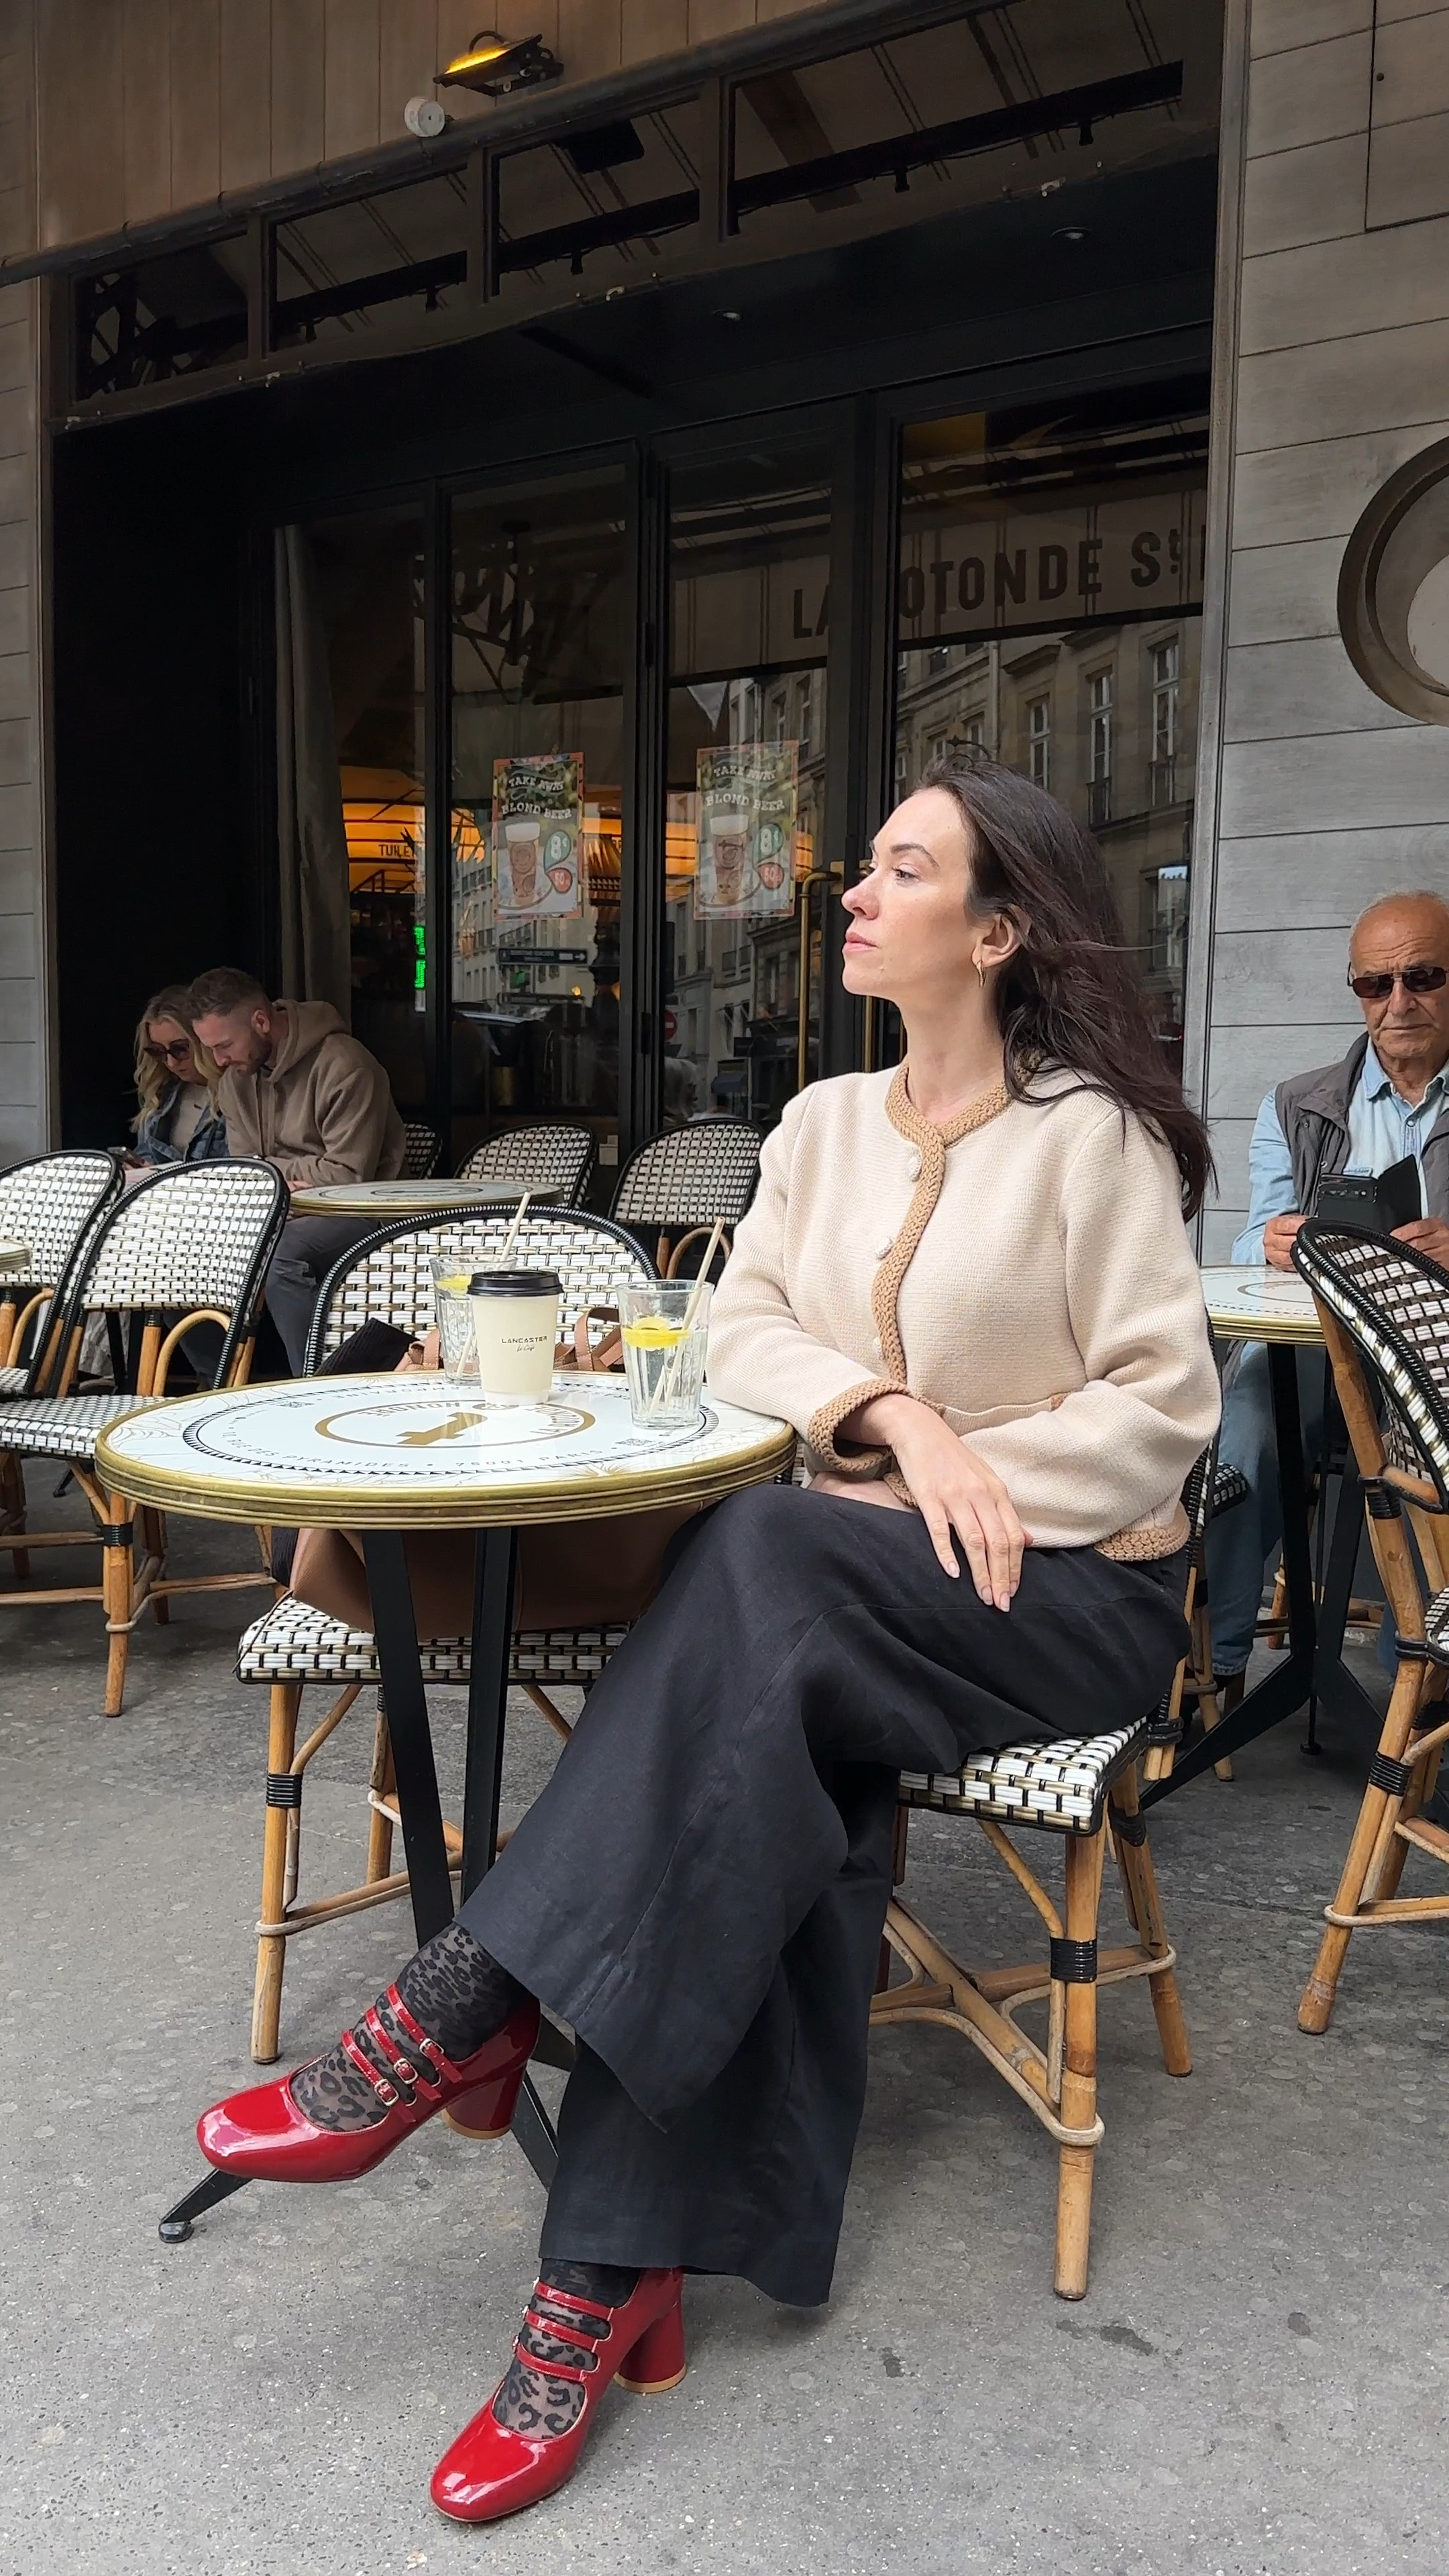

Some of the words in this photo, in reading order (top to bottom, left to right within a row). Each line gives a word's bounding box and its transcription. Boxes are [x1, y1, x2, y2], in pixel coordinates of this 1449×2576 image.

[899, 539, 1104, 619] OTONDE
[713, 765, 745, 777] TAKE
[746, 769, 776, 780] AWAY
[508, 776, 537, 787] TAKE
[537, 780, 565, 792] AWAY
[501, 802, 541, 814] BLOND
[544, 808, 572, 819] BEER
[705, 793, 750, 806] BLOND
[753, 799, 785, 811] BEER
[501, 1336, 547, 1344] LANCASTER
[250, 1447, 280, 1456] DES
[282, 1455, 409, 1468] PYRAMIDES
[538, 1449, 603, 1462] PARIS
